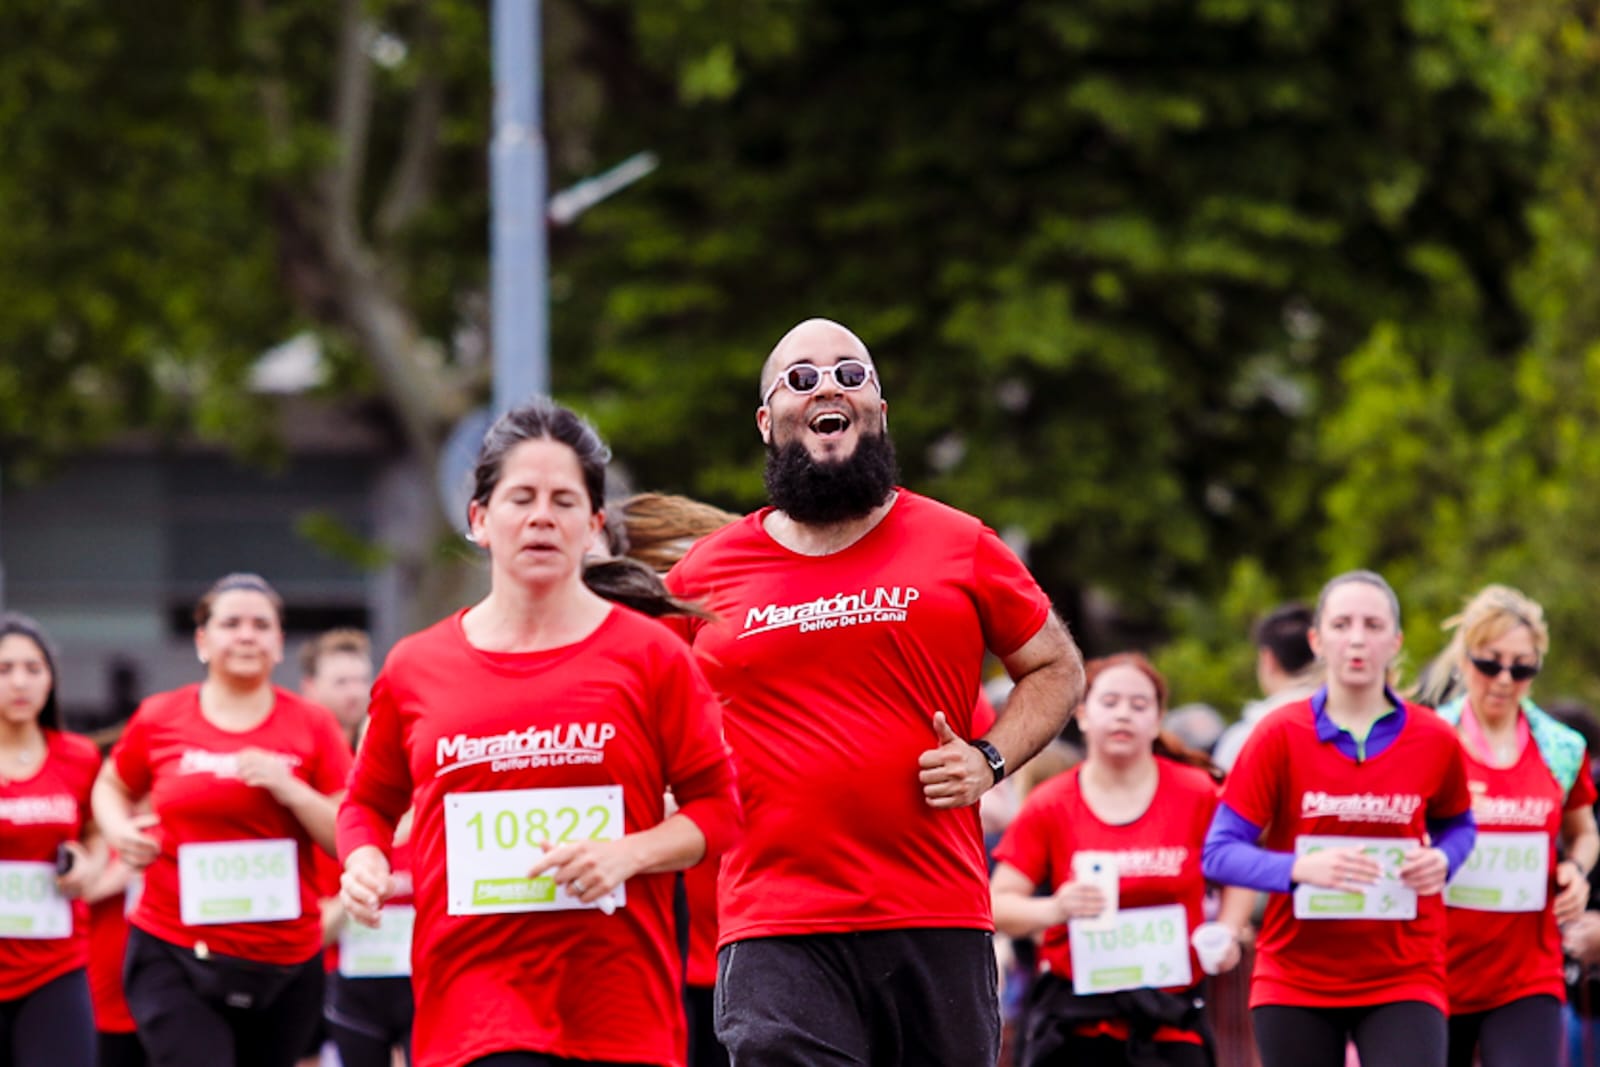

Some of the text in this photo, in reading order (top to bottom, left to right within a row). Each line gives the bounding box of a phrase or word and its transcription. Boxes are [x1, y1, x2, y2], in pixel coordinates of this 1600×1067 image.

[799, 610, 907, 633] Delfor De La Canal
[491, 751, 605, 773] Delfor De La Canal
[466, 804, 612, 851] 10822
[195, 850, 288, 882] 10956
[1465, 844, 1540, 873] 0786
[1081, 918, 1176, 954] 10849
